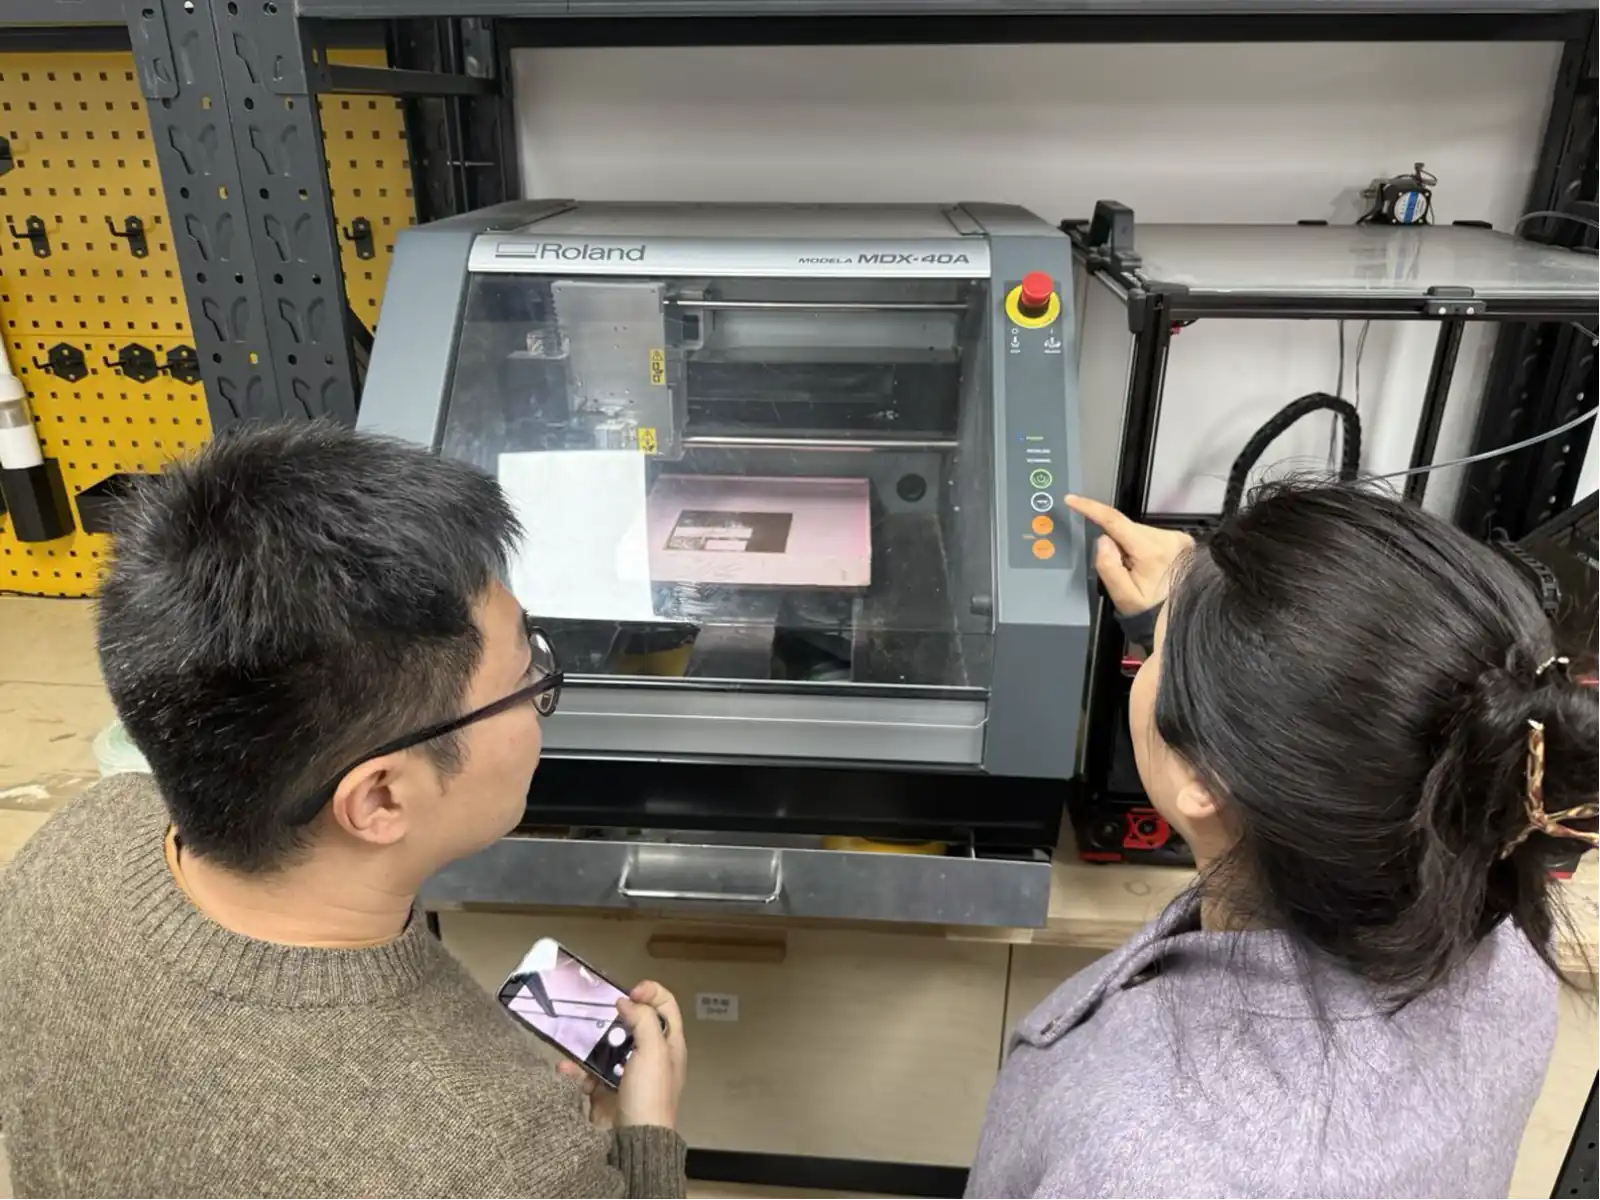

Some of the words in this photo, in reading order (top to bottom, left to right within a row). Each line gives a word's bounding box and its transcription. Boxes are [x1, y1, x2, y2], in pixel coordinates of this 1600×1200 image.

[541, 243, 646, 261] Roland
[798, 257, 853, 265] MODELA
[857, 254, 970, 265] MDX-40A
